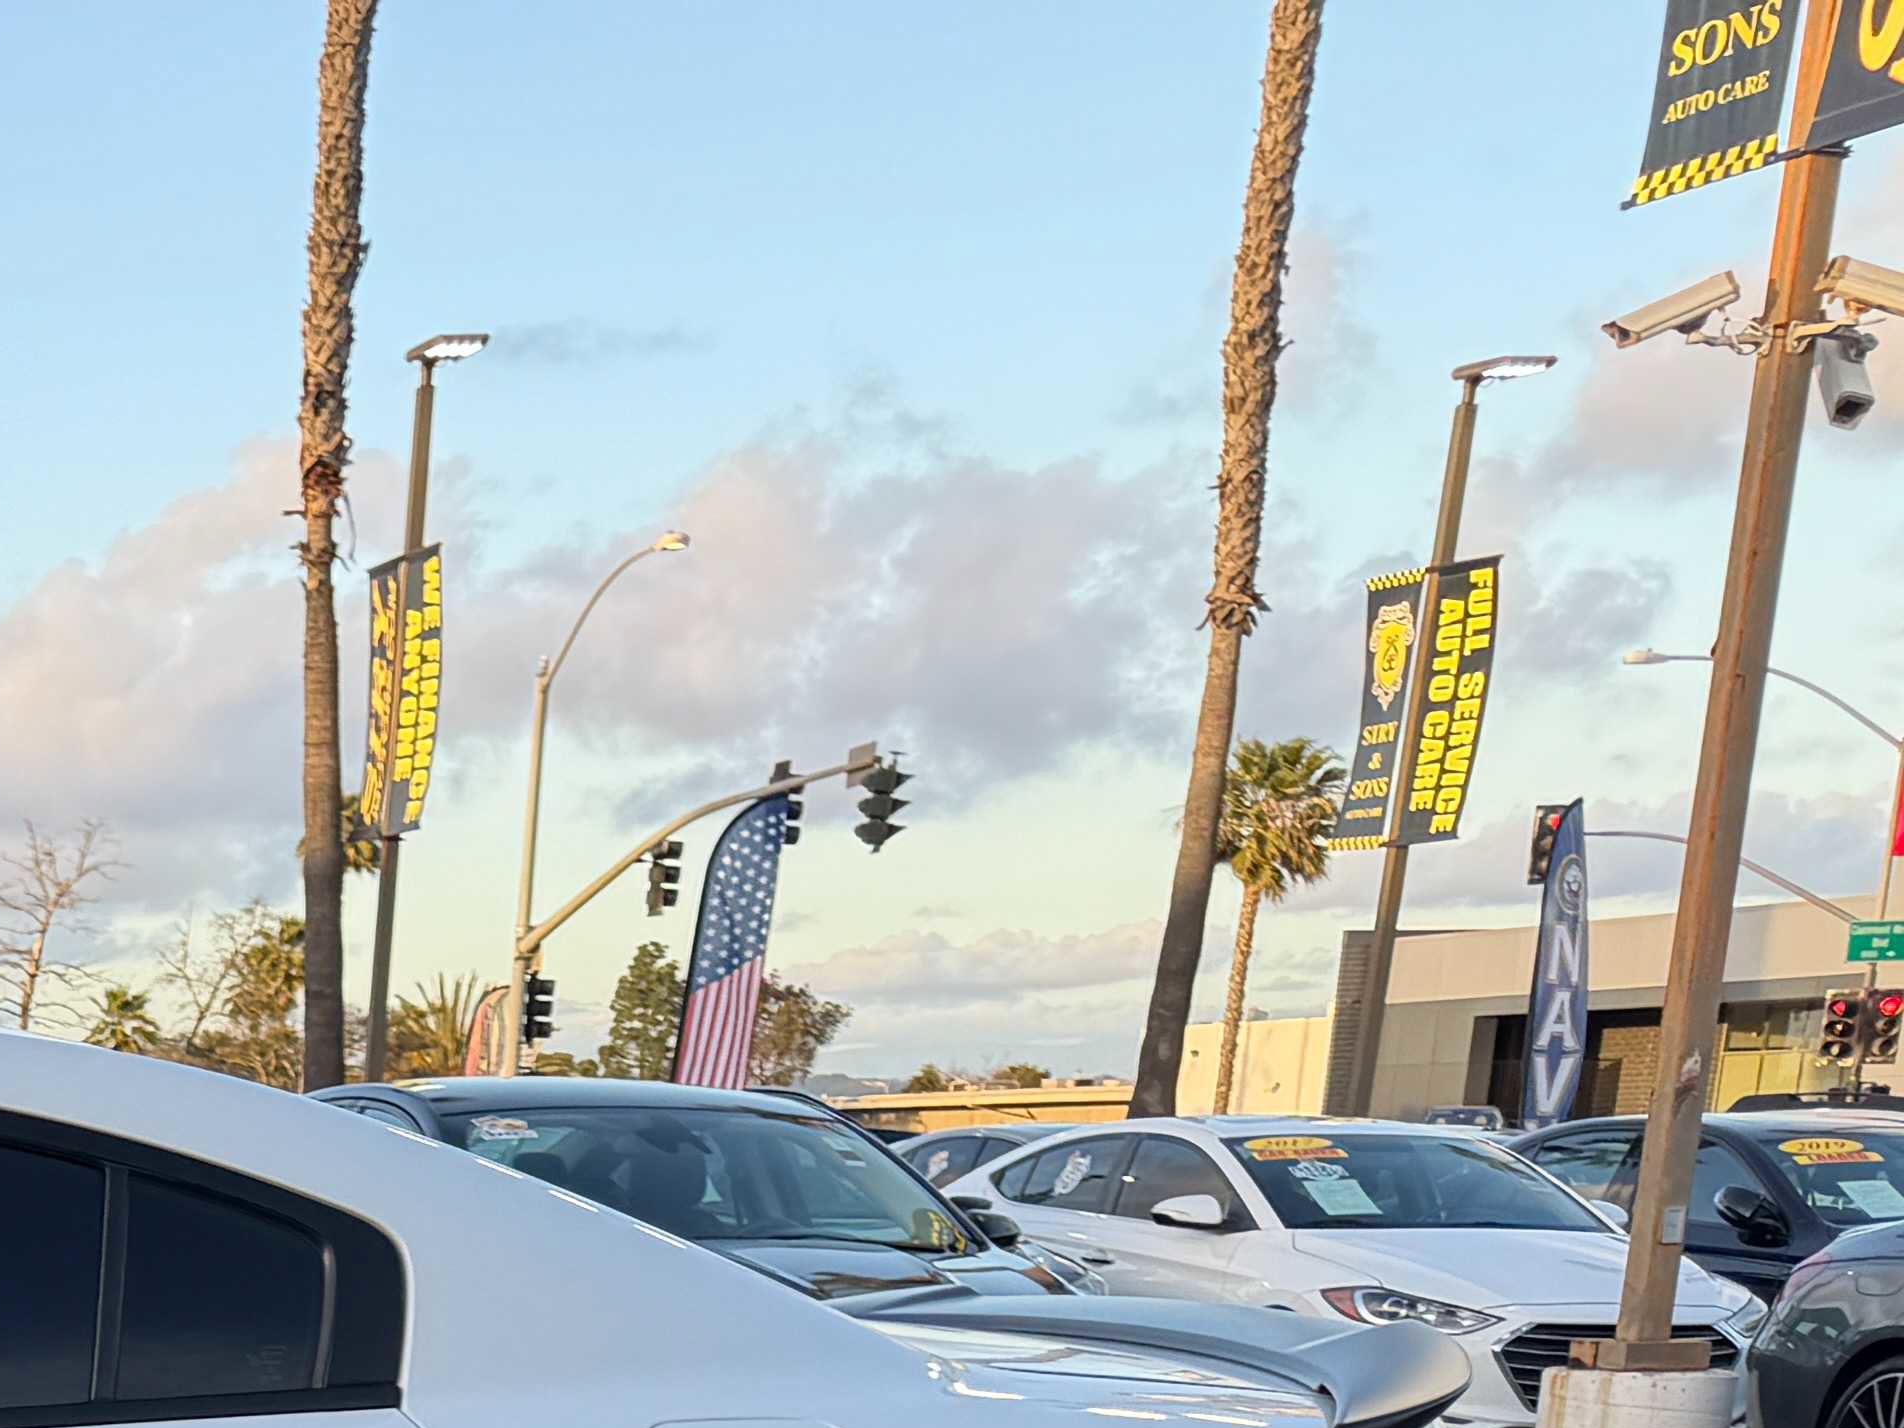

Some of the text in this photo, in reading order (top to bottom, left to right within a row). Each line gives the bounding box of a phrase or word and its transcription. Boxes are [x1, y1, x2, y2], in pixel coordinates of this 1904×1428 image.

[1661, 70, 1771, 125] AUTO CARE
[1667, 0, 1782, 77] SONS
[393, 609, 423, 782] ANYONE
[404, 555, 441, 825] WE FINANCE
[1409, 598, 1465, 812] AUTO CARE
[1429, 567, 1494, 835] FULL SERVICE
